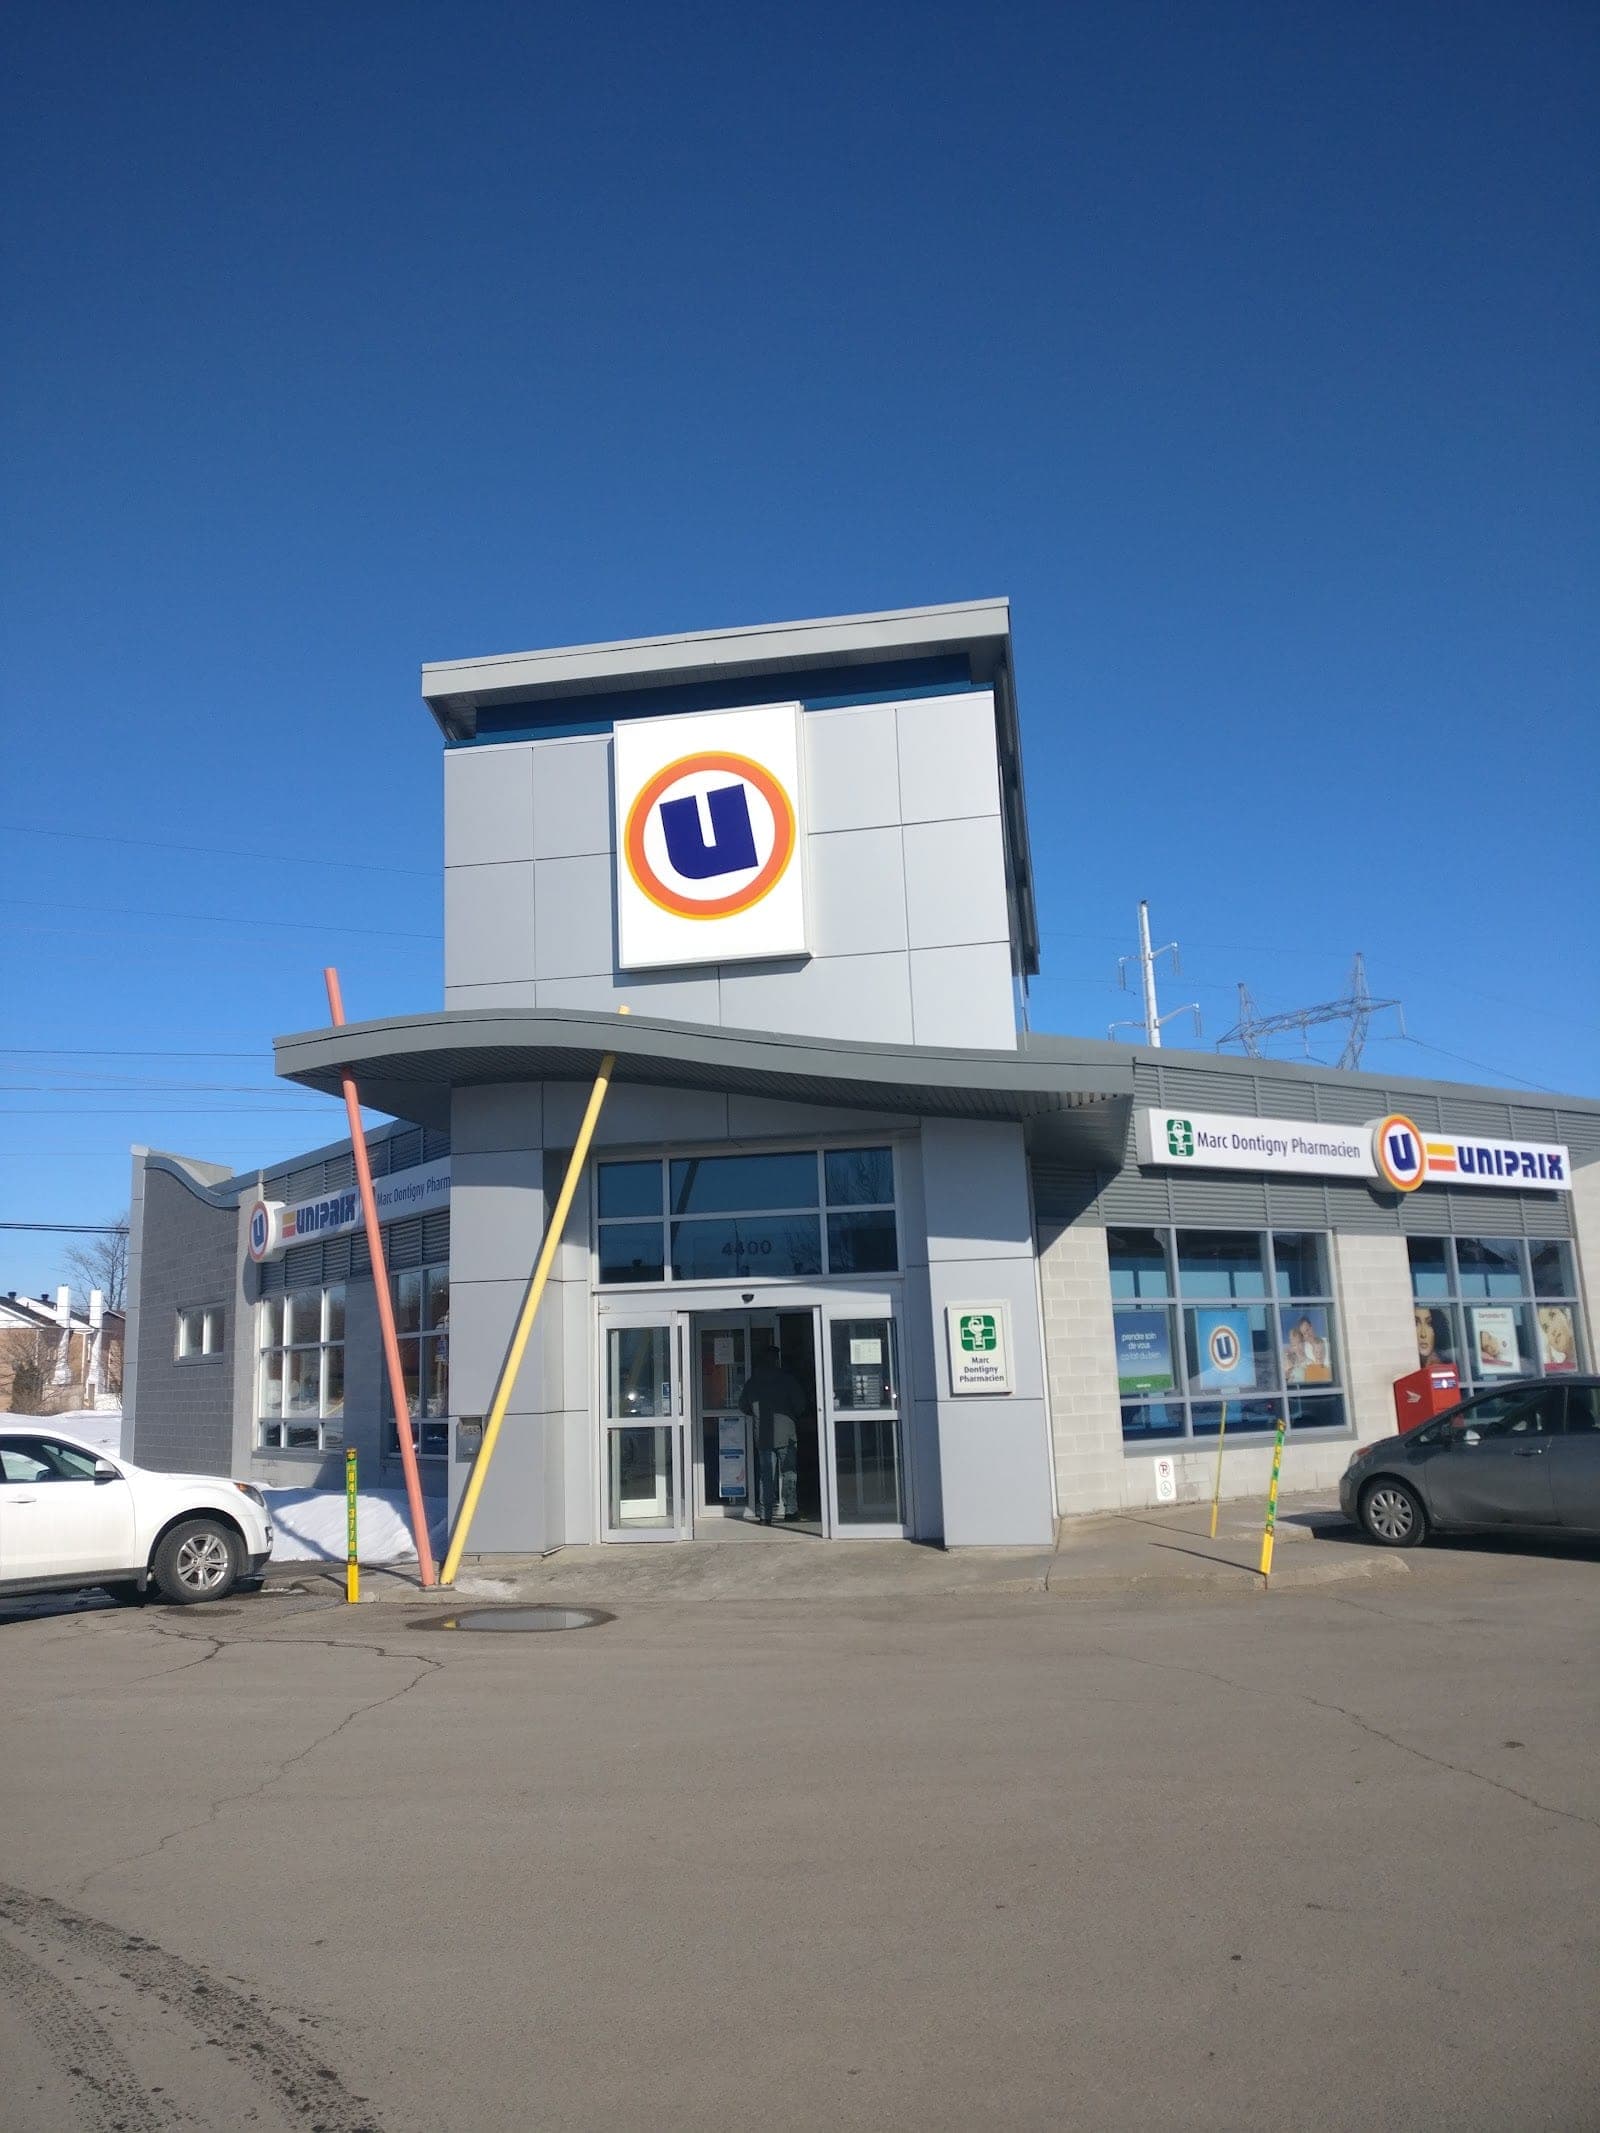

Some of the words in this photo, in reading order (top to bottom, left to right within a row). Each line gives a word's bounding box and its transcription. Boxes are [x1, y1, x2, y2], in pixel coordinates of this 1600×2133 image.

[1197, 1131, 1229, 1149] Marc
[1232, 1134, 1289, 1157] Dontigny
[1291, 1139, 1361, 1158] Pharmacien
[1457, 1145, 1565, 1181] UNIPRIX
[377, 1191, 393, 1206] Marc
[393, 1183, 425, 1203] Dontigny
[296, 1193, 355, 1234] UNIPRIX
[722, 1240, 773, 1256] 4400
[959, 1374, 1004, 1383] Pharmacien
[964, 1366, 998, 1374] Dontigny
